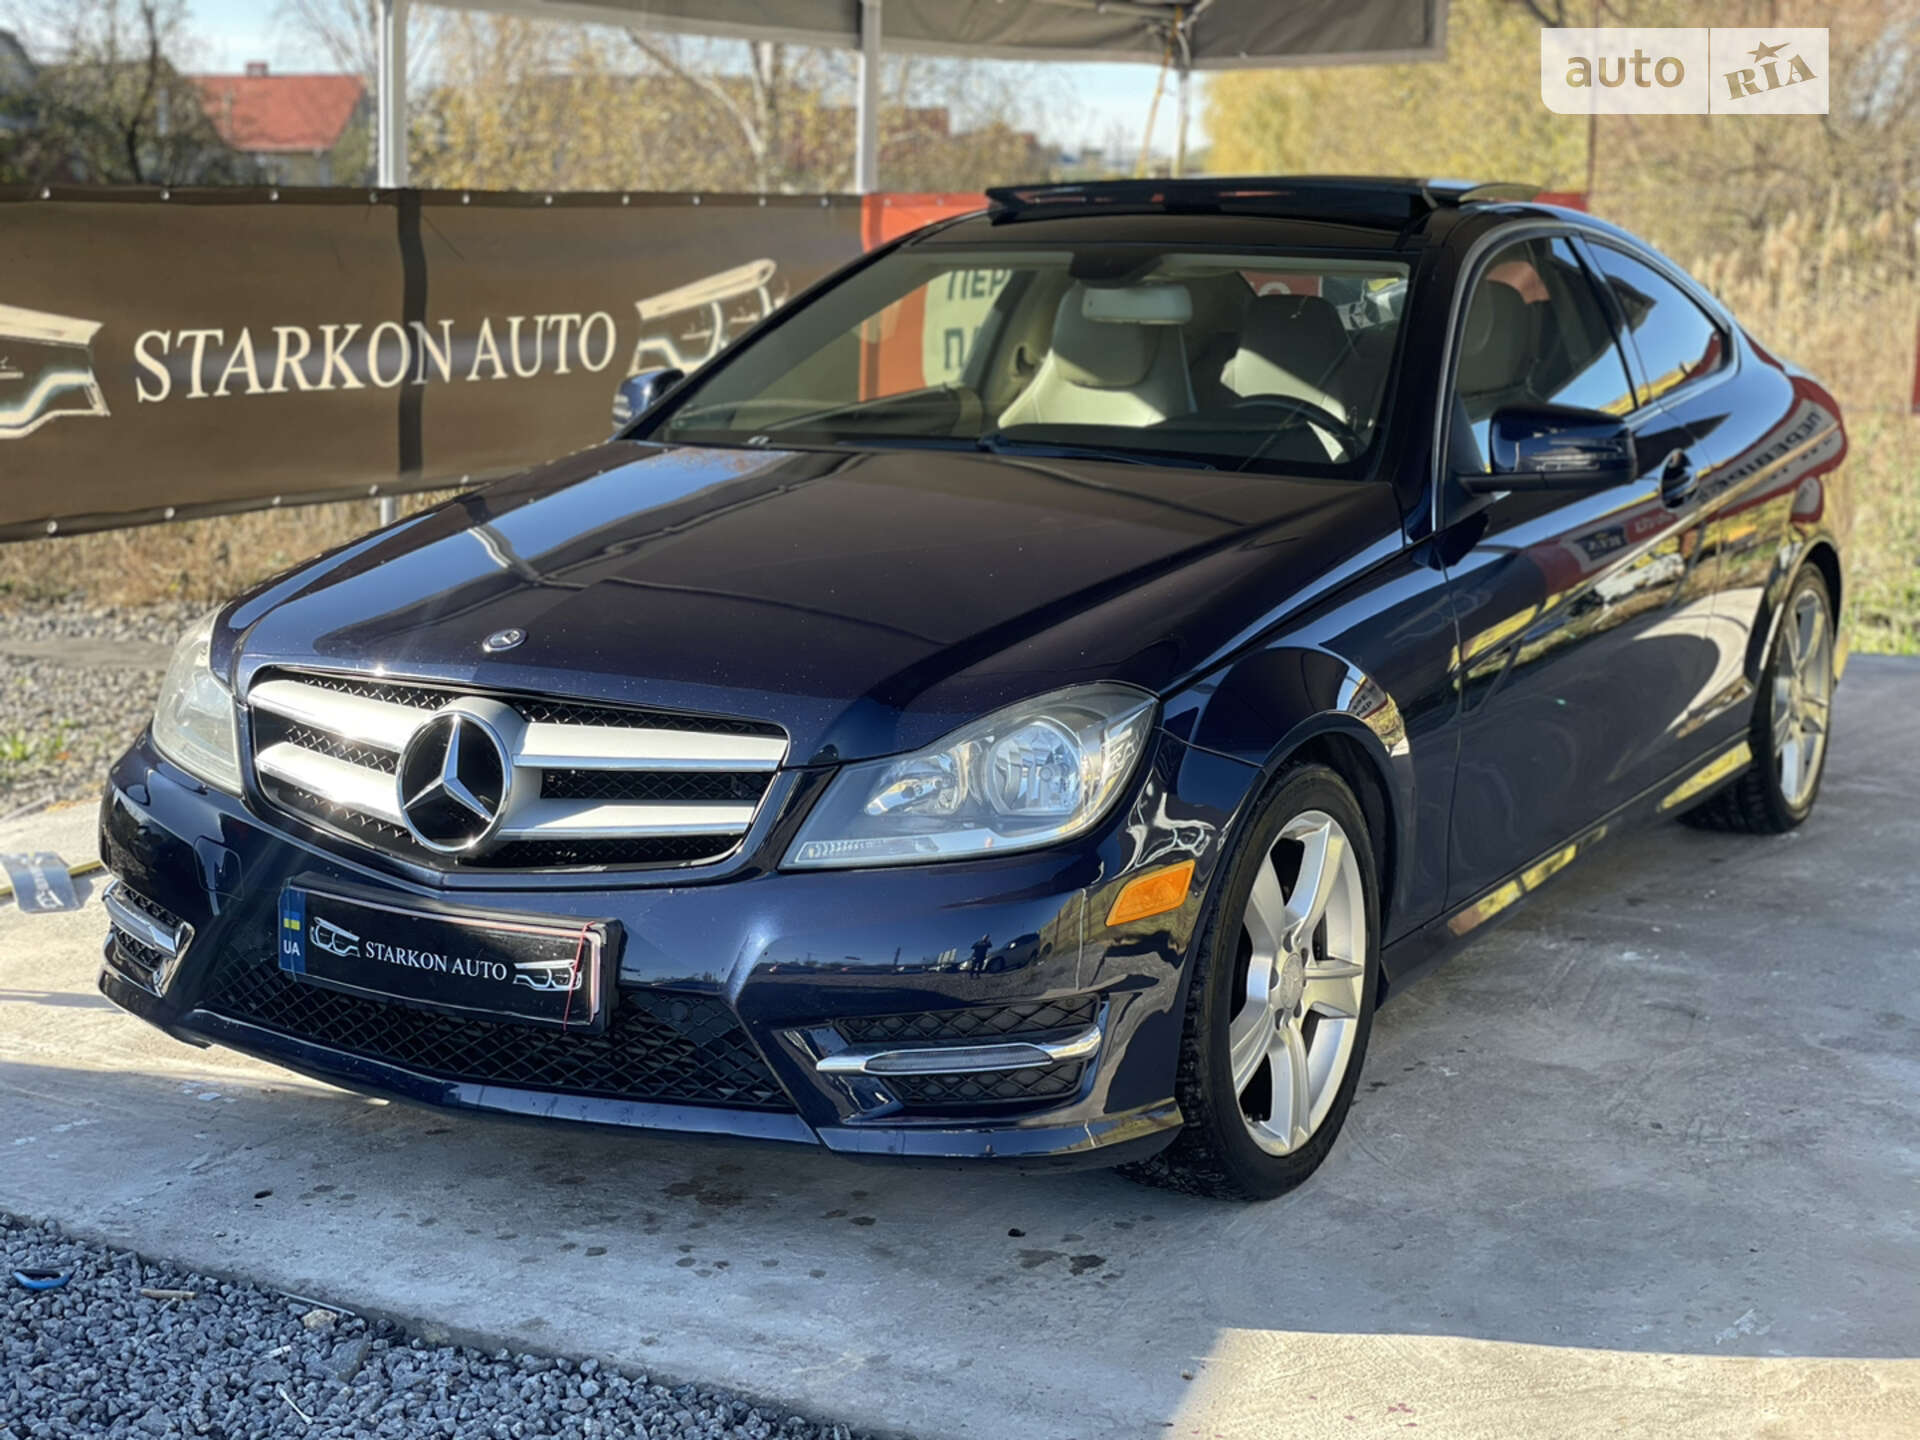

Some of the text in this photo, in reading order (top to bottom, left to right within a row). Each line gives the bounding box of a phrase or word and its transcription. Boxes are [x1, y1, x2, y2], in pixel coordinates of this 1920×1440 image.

[133, 310, 618, 404] STARKON AUTO
[283, 940, 301, 957] UA
[365, 941, 508, 982] STARKON AUTO
